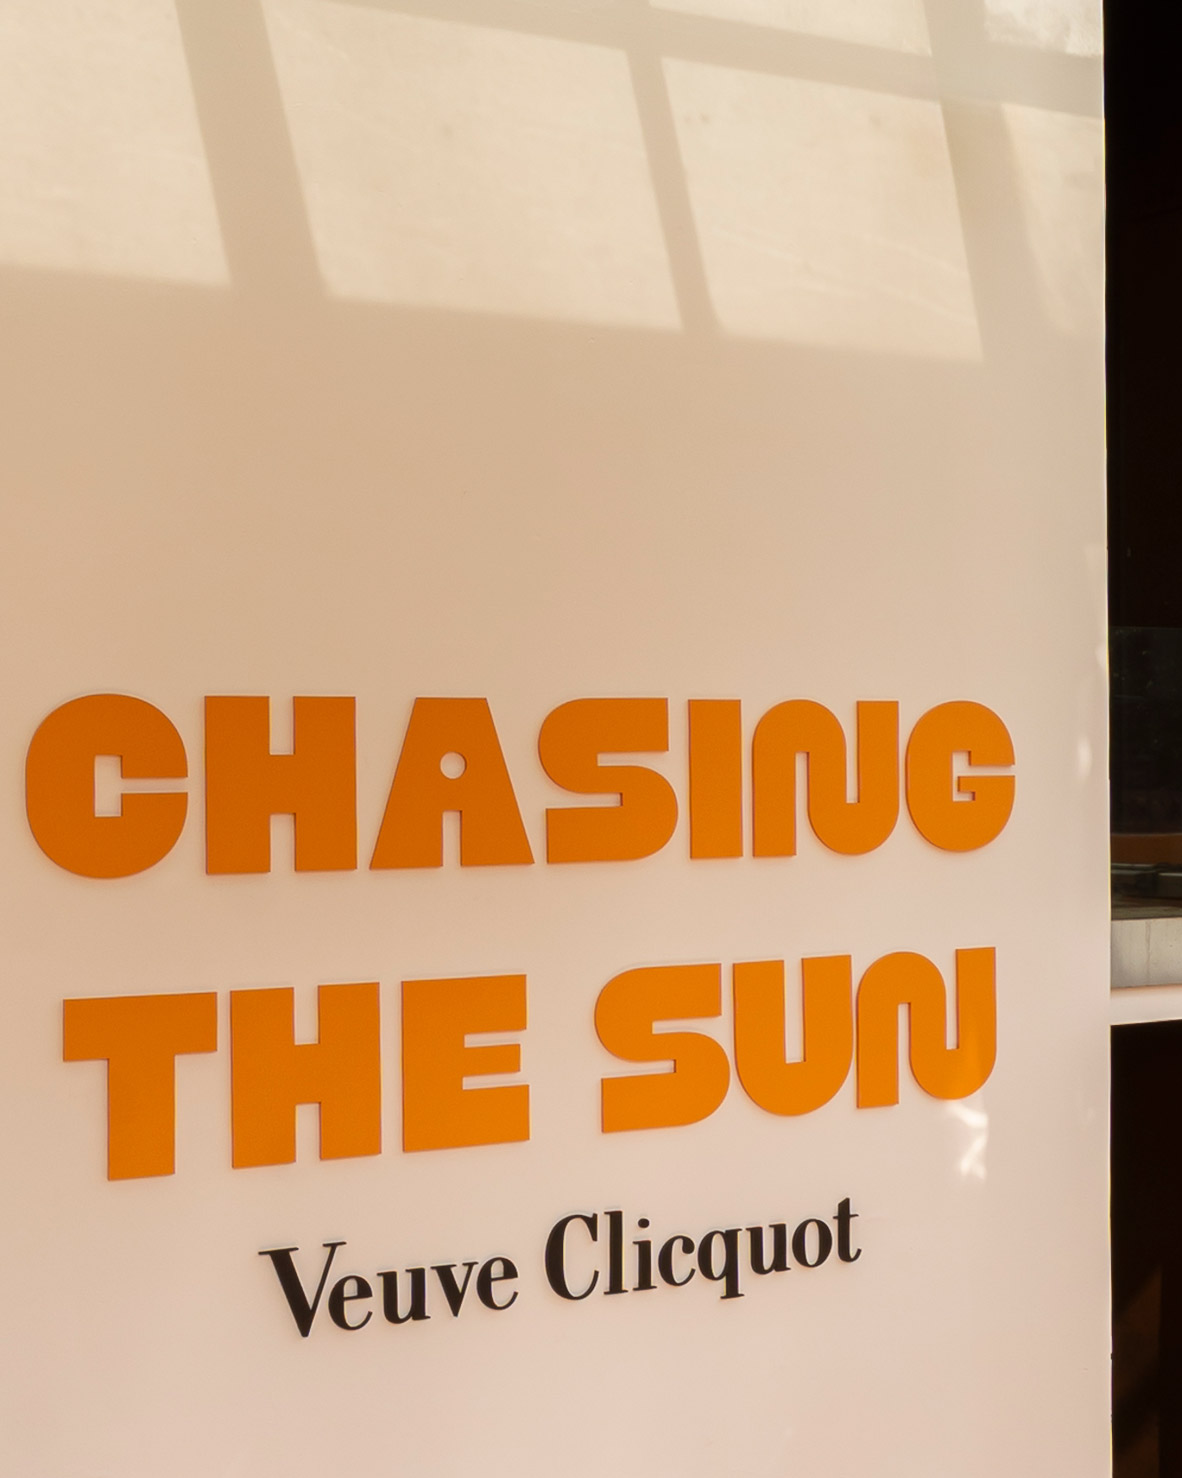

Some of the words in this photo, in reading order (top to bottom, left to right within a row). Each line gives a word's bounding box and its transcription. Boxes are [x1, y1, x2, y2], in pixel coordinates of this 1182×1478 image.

[24, 693, 1017, 881] CHASING
[61, 972, 531, 1182] THE
[592, 946, 997, 1135] SUN
[257, 1240, 519, 1338] Veuve
[544, 1196, 862, 1301] Clicquot
